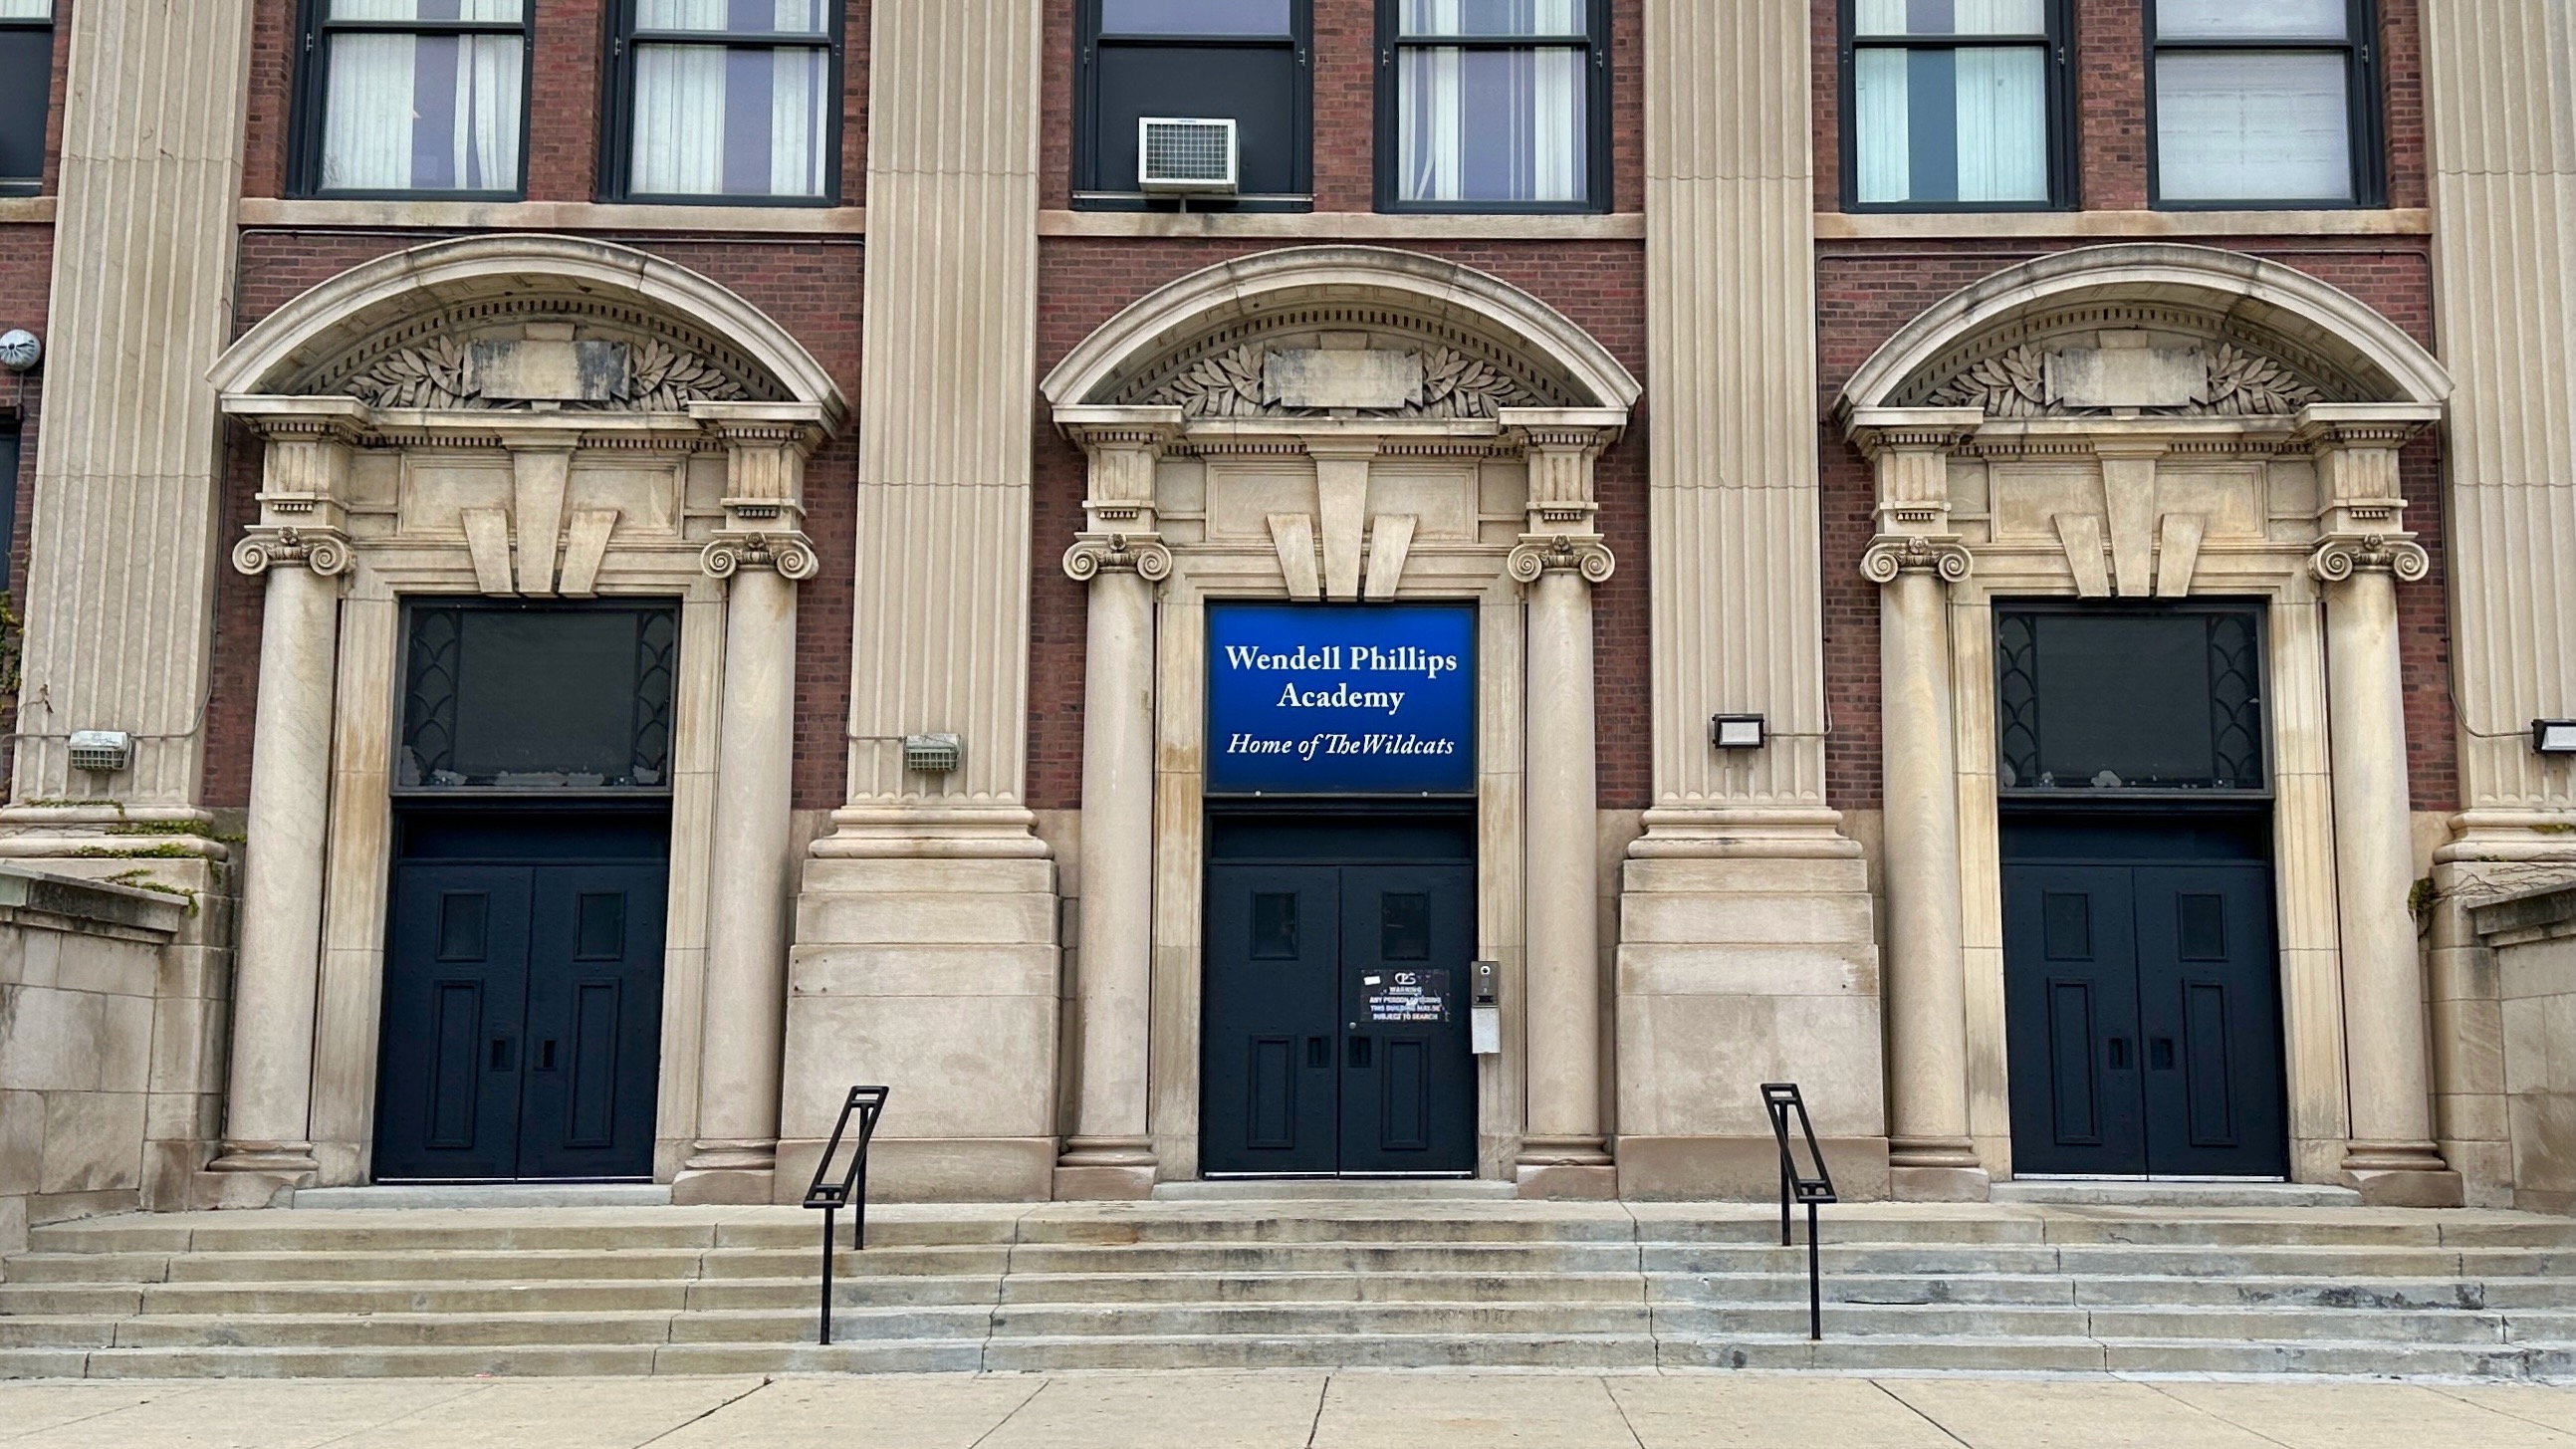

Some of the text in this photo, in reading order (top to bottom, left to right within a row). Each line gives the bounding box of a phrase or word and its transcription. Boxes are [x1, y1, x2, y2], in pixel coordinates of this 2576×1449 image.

[1224, 645, 1458, 679] Wendell Phillips
[1276, 682, 1406, 716] Academy
[1226, 733, 1292, 755] Home
[1297, 733, 1324, 762] of
[1389, 986, 1423, 995] WARNING
